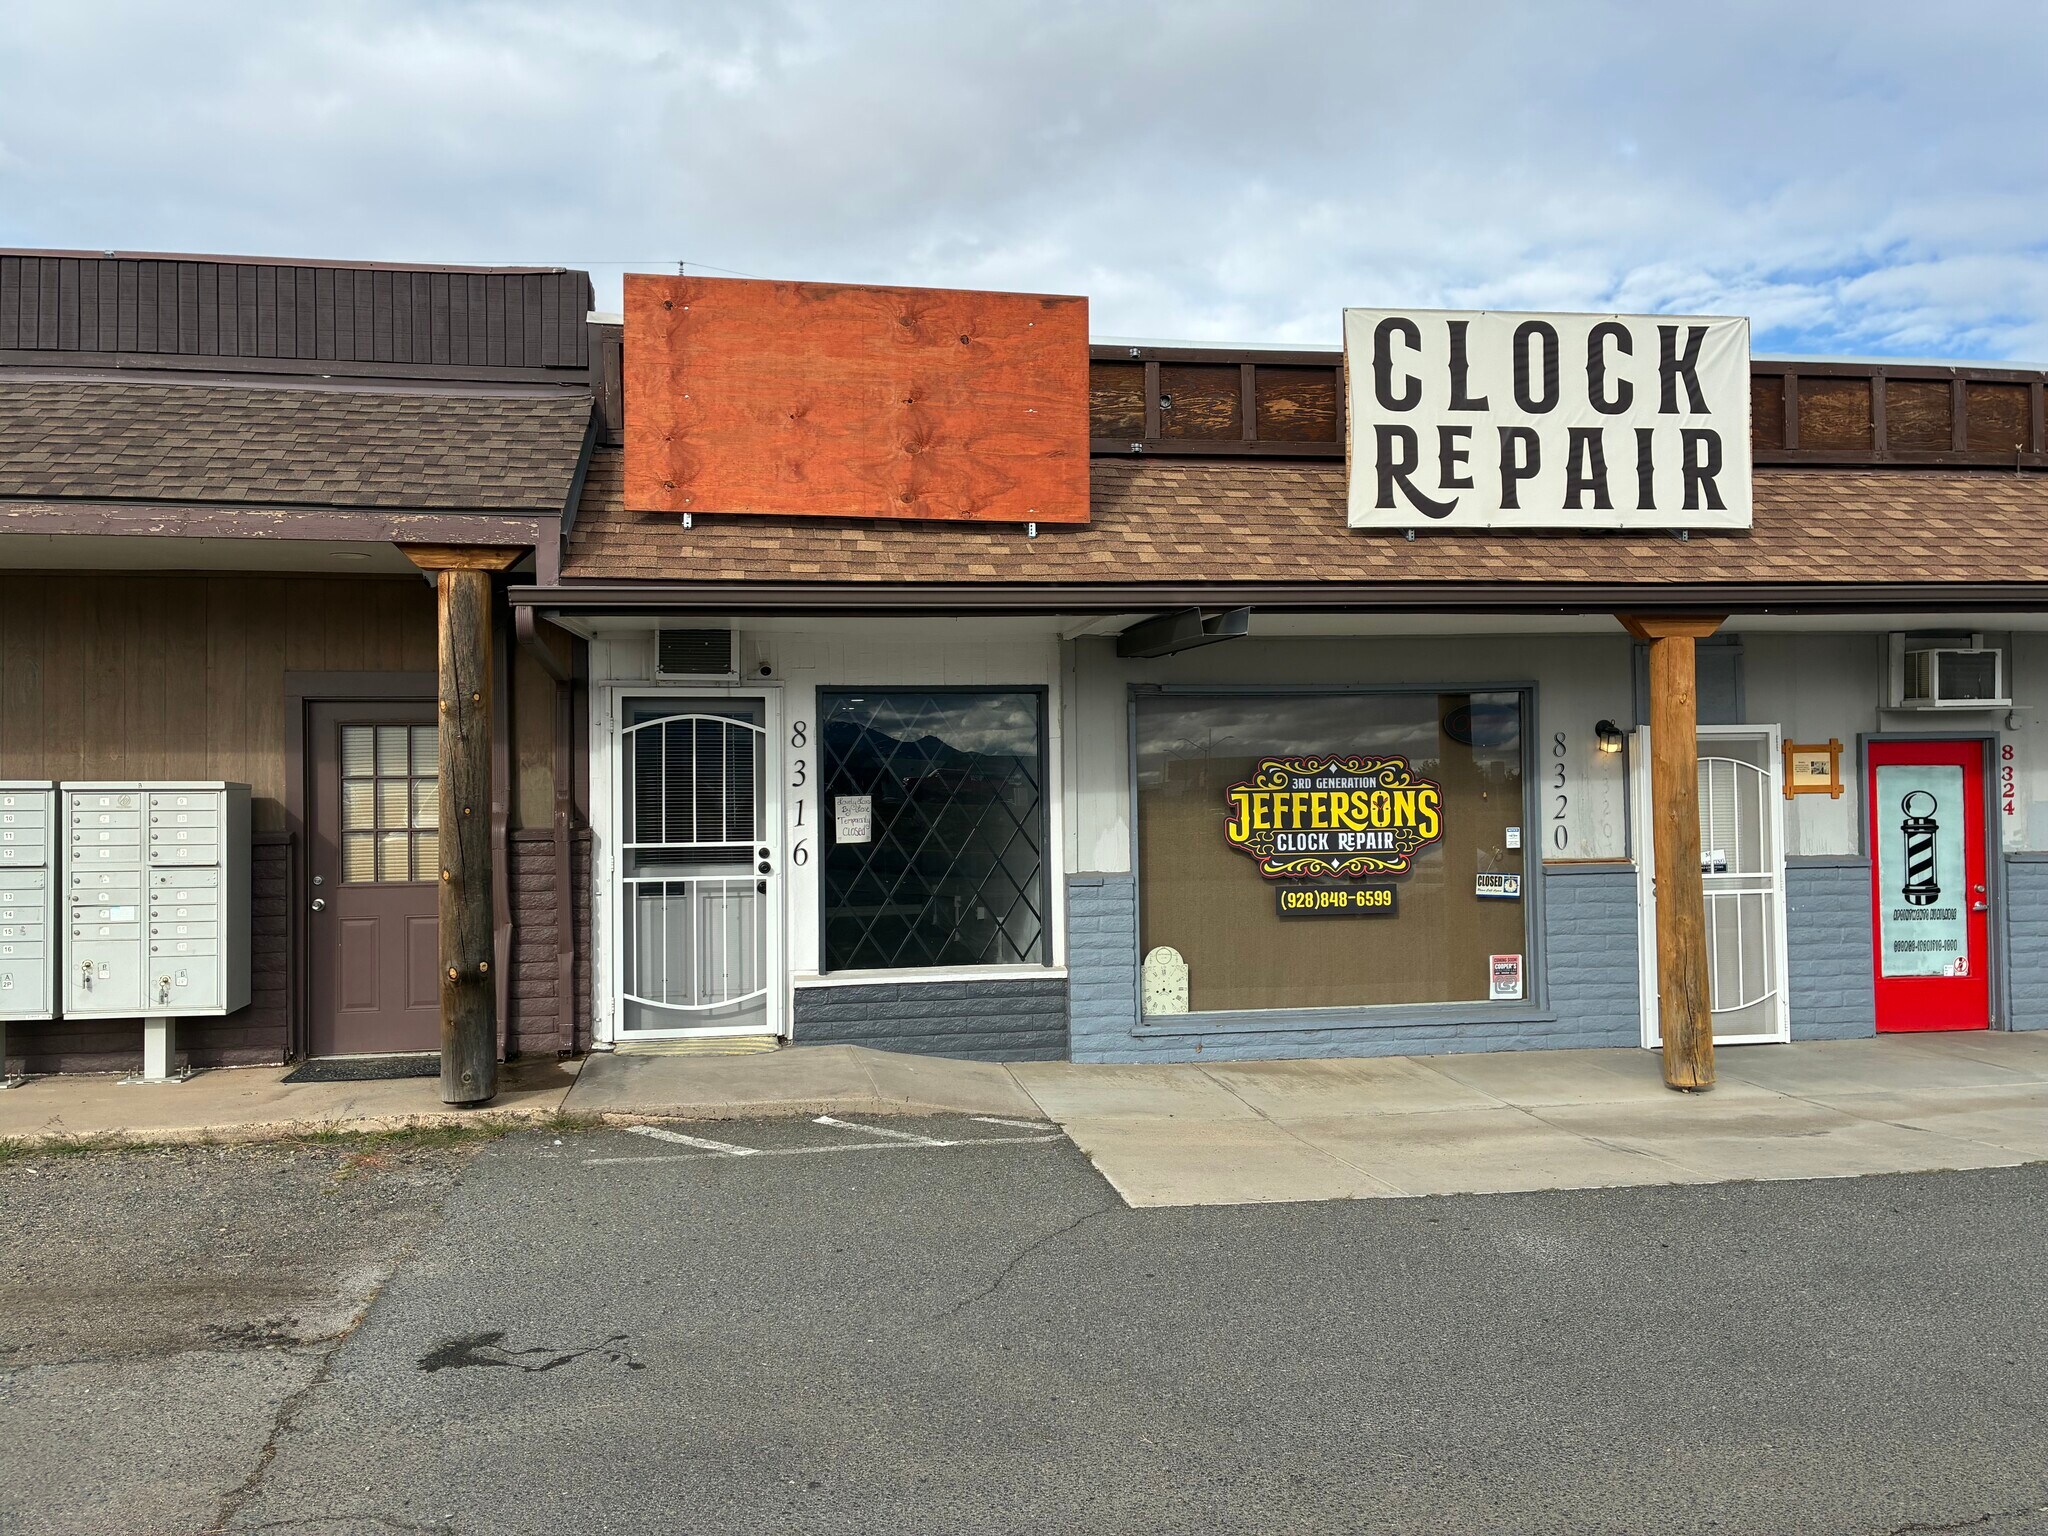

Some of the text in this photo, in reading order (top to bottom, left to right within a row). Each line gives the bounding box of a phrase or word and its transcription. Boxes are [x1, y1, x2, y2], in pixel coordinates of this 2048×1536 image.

[1372, 317, 1712, 415] CLOCK
[1373, 424, 1728, 519] REPAIR
[791, 720, 808, 866] 8316
[1292, 777, 1377, 789] 3RD GENERATION
[1552, 731, 1568, 851] 8320
[2001, 744, 2015, 815] 8324
[1229, 790, 1439, 842] JEFFERSONS
[1277, 832, 1394, 851] CLOCK REPAIR
[1281, 890, 1392, 911] (928)848-6599
[1477, 875, 1503, 887] CLOSED
